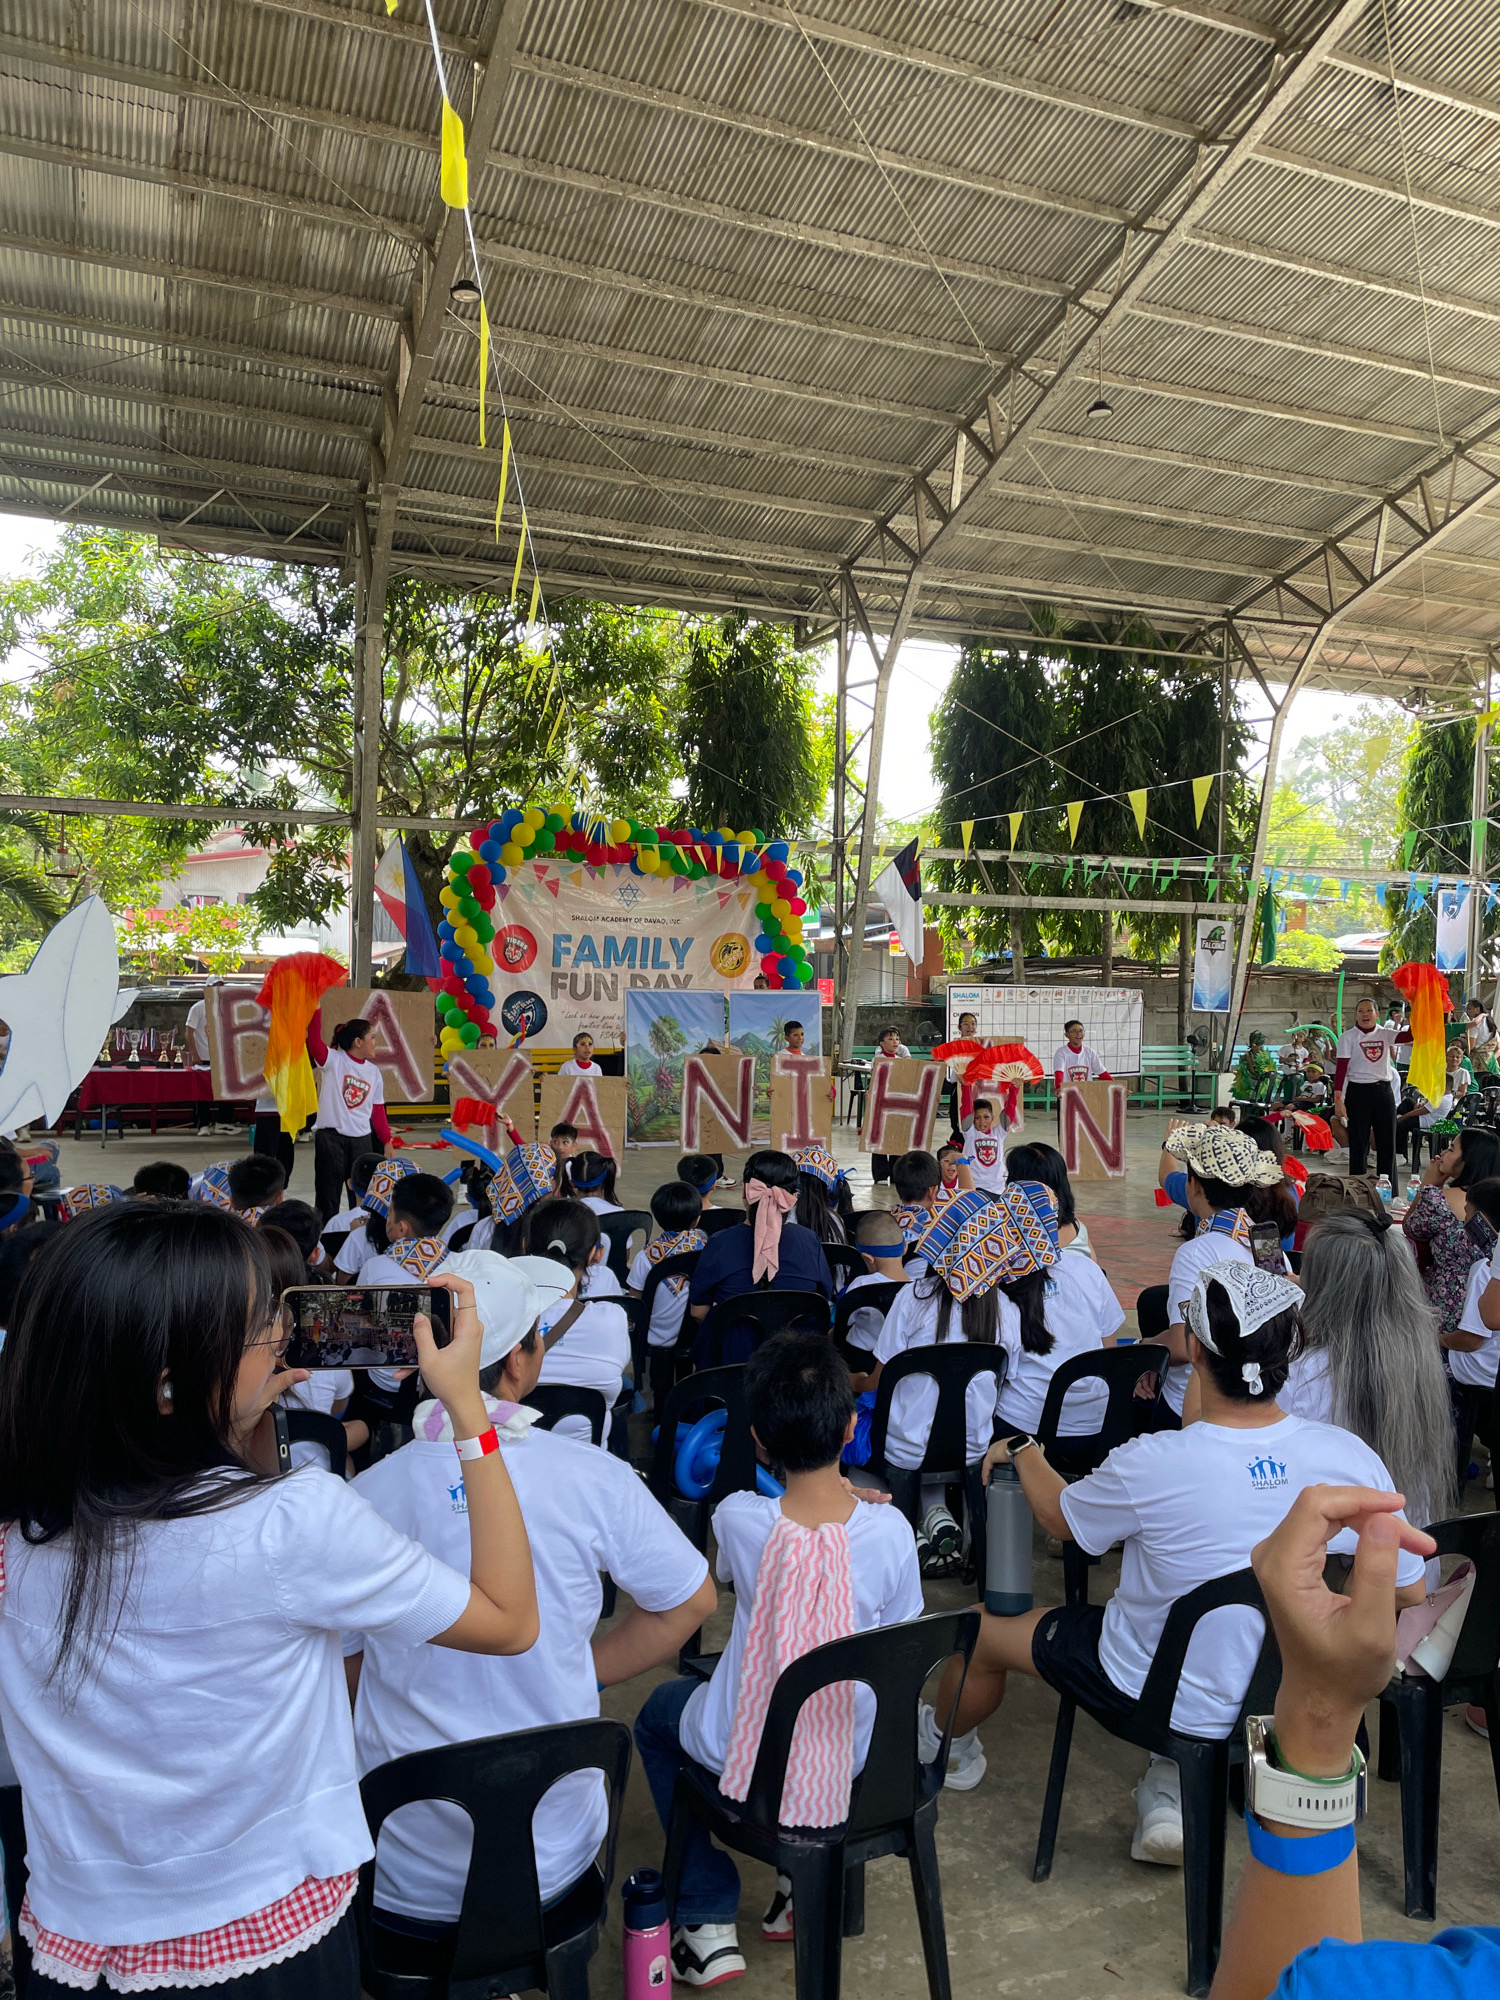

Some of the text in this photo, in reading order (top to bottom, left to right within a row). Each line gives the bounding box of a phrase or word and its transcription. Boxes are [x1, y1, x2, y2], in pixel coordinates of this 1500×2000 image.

[571, 914, 600, 922] SHALOM
[506, 936, 528, 950] TIGERS
[1201, 941, 1225, 949] FALCONS
[552, 933, 695, 970] FAMILY
[550, 971, 619, 1001] FUN
[600, 1013, 616, 1022] good
[346, 1077, 370, 1091] TIGERS
[1252, 1478, 1289, 1487] SHALOM
